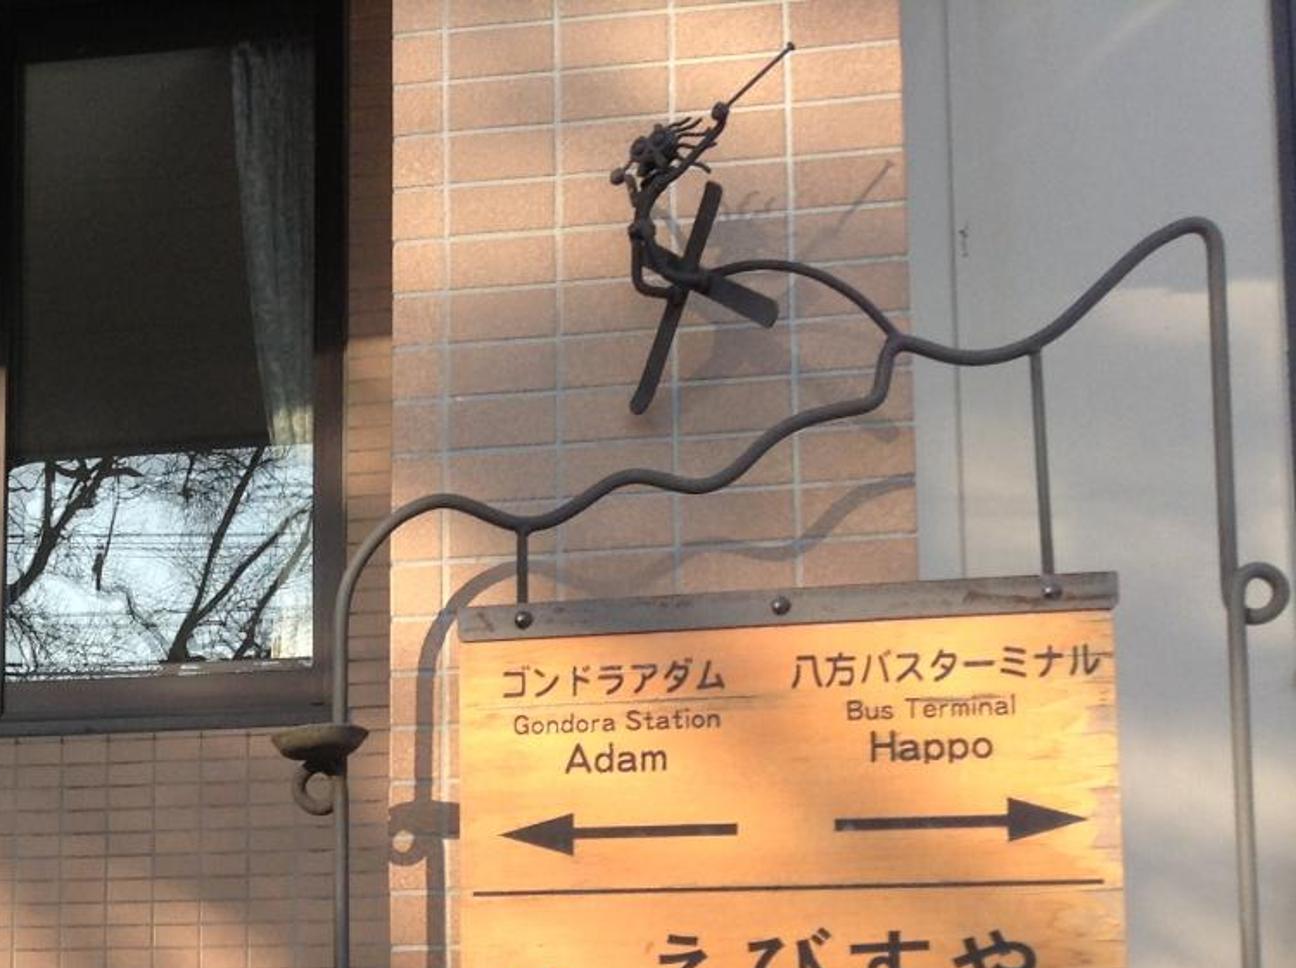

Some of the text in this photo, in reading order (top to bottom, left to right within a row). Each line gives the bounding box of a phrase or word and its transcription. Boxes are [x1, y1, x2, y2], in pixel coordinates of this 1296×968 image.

[502, 657, 726, 699] ゴンドラアダム
[791, 644, 1102, 690] 八方バスターミナル
[514, 708, 722, 736] Gondora Station
[846, 694, 1017, 721] Bus Terminal
[565, 742, 668, 775] Adam
[870, 729, 994, 764] Happo
